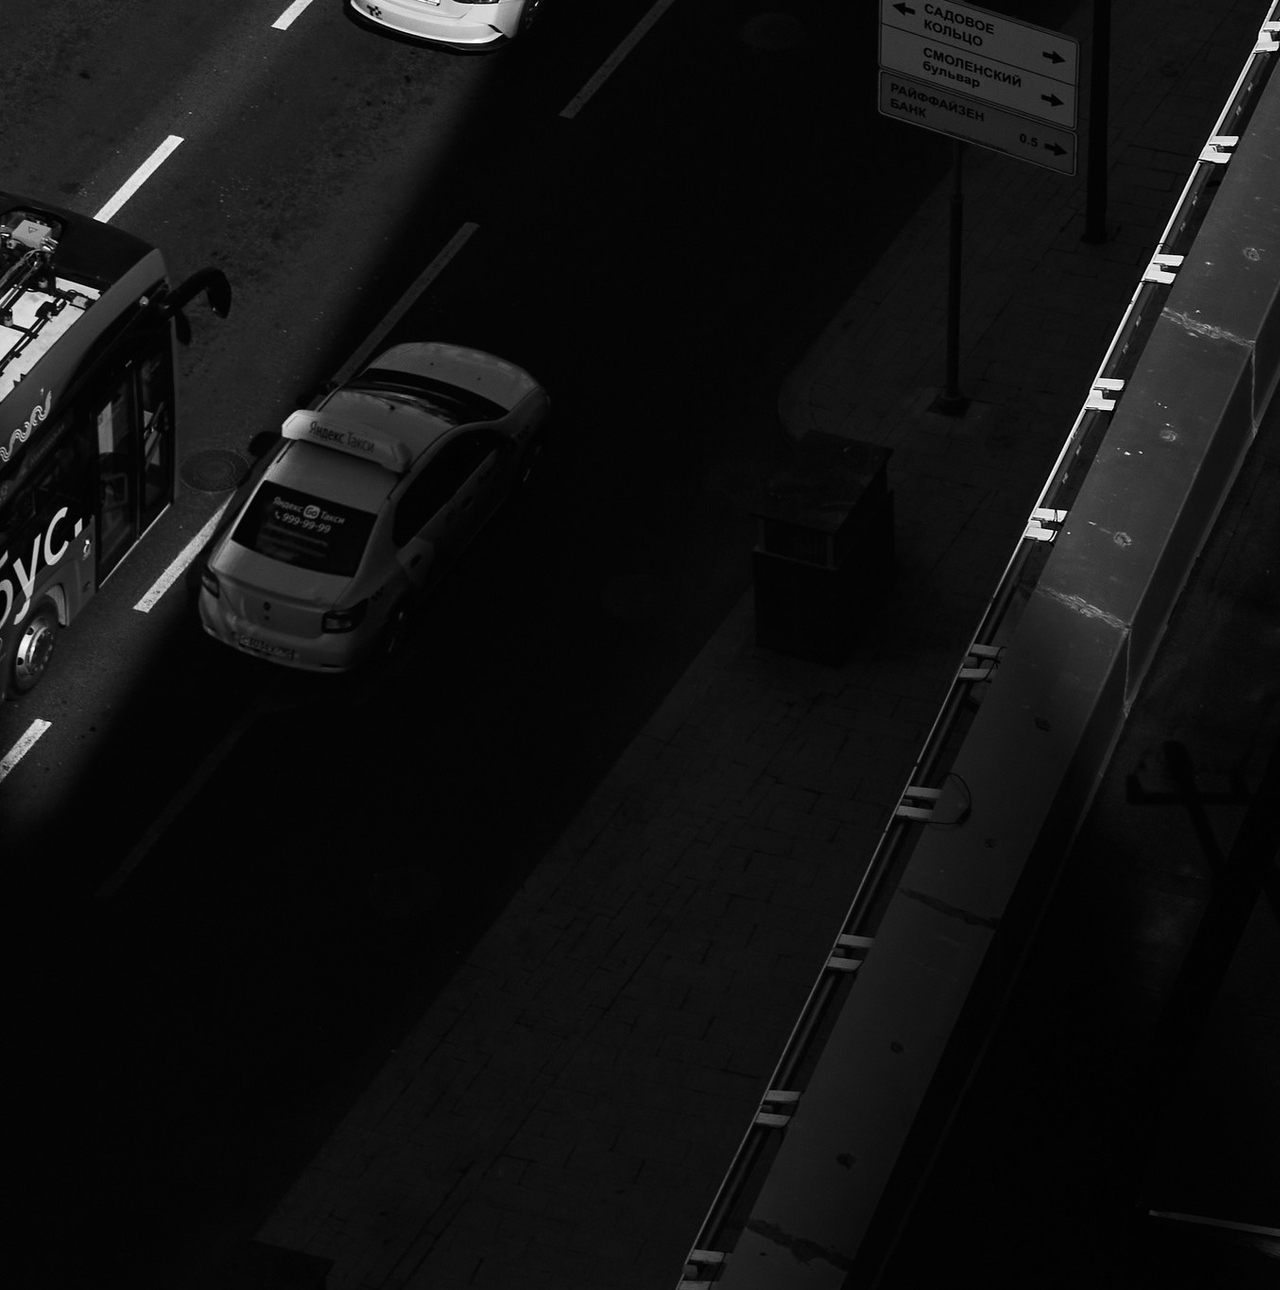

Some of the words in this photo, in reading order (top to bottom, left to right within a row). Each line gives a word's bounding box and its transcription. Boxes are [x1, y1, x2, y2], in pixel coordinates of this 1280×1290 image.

[923, 19, 984, 47] КОЛЬЦО
[924, 3, 995, 35] САДОВОЕ
[922, 61, 980, 88] бульвар
[923, 47, 1022, 88] СМОЛЕНСКИЙ
[890, 83, 985, 122] РАЙФФАЙЗЕН
[890, 98, 927, 118] БАНК
[1019, 133, 1038, 147] 0.5
[309, 420, 345, 445] Яндекс
[346, 431, 376, 453] Такси
[272, 496, 304, 513] Яндекс
[320, 511, 346, 525] Такси
[281, 512, 332, 534] 999-99-99
